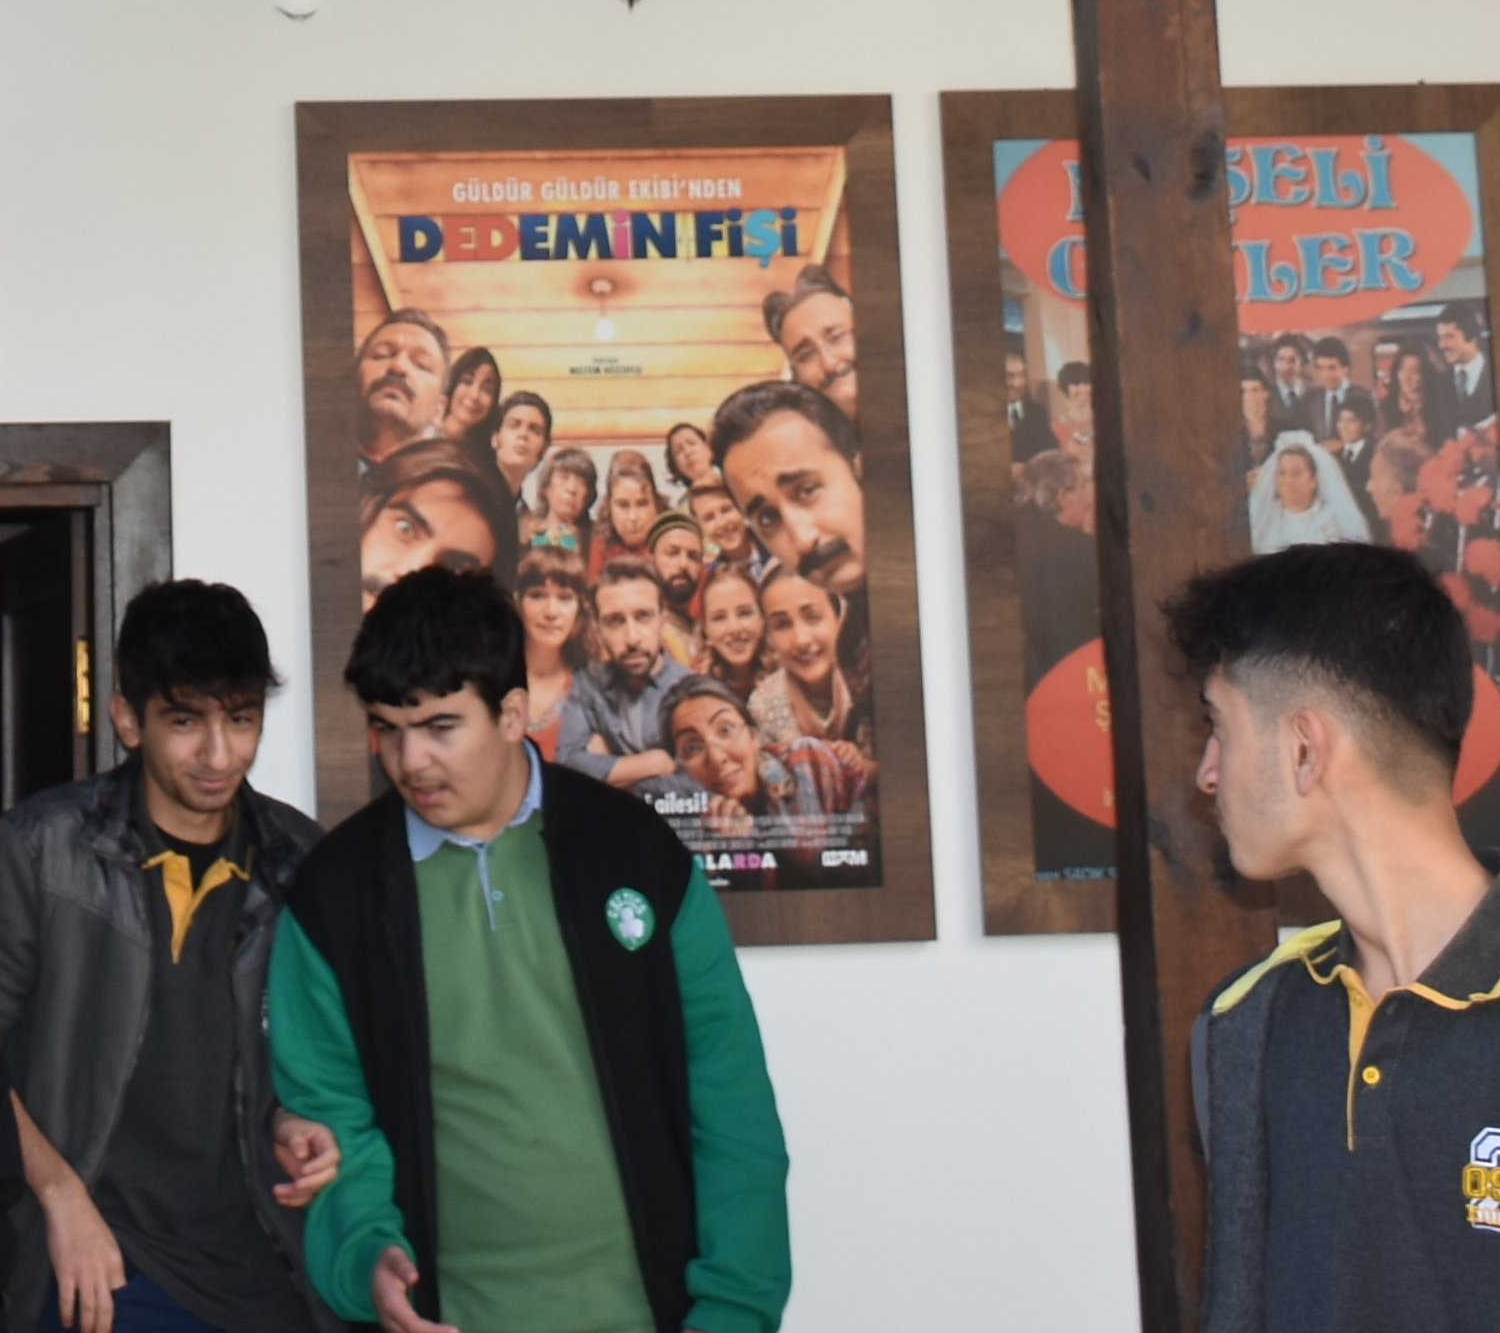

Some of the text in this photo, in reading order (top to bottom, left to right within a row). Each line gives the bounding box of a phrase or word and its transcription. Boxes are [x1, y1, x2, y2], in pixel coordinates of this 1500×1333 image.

[451, 177, 533, 203] GÜLDÜR
[540, 175, 621, 202] GÜLDÜR
[398, 206, 799, 269] DEDEMİN FİŞİ
